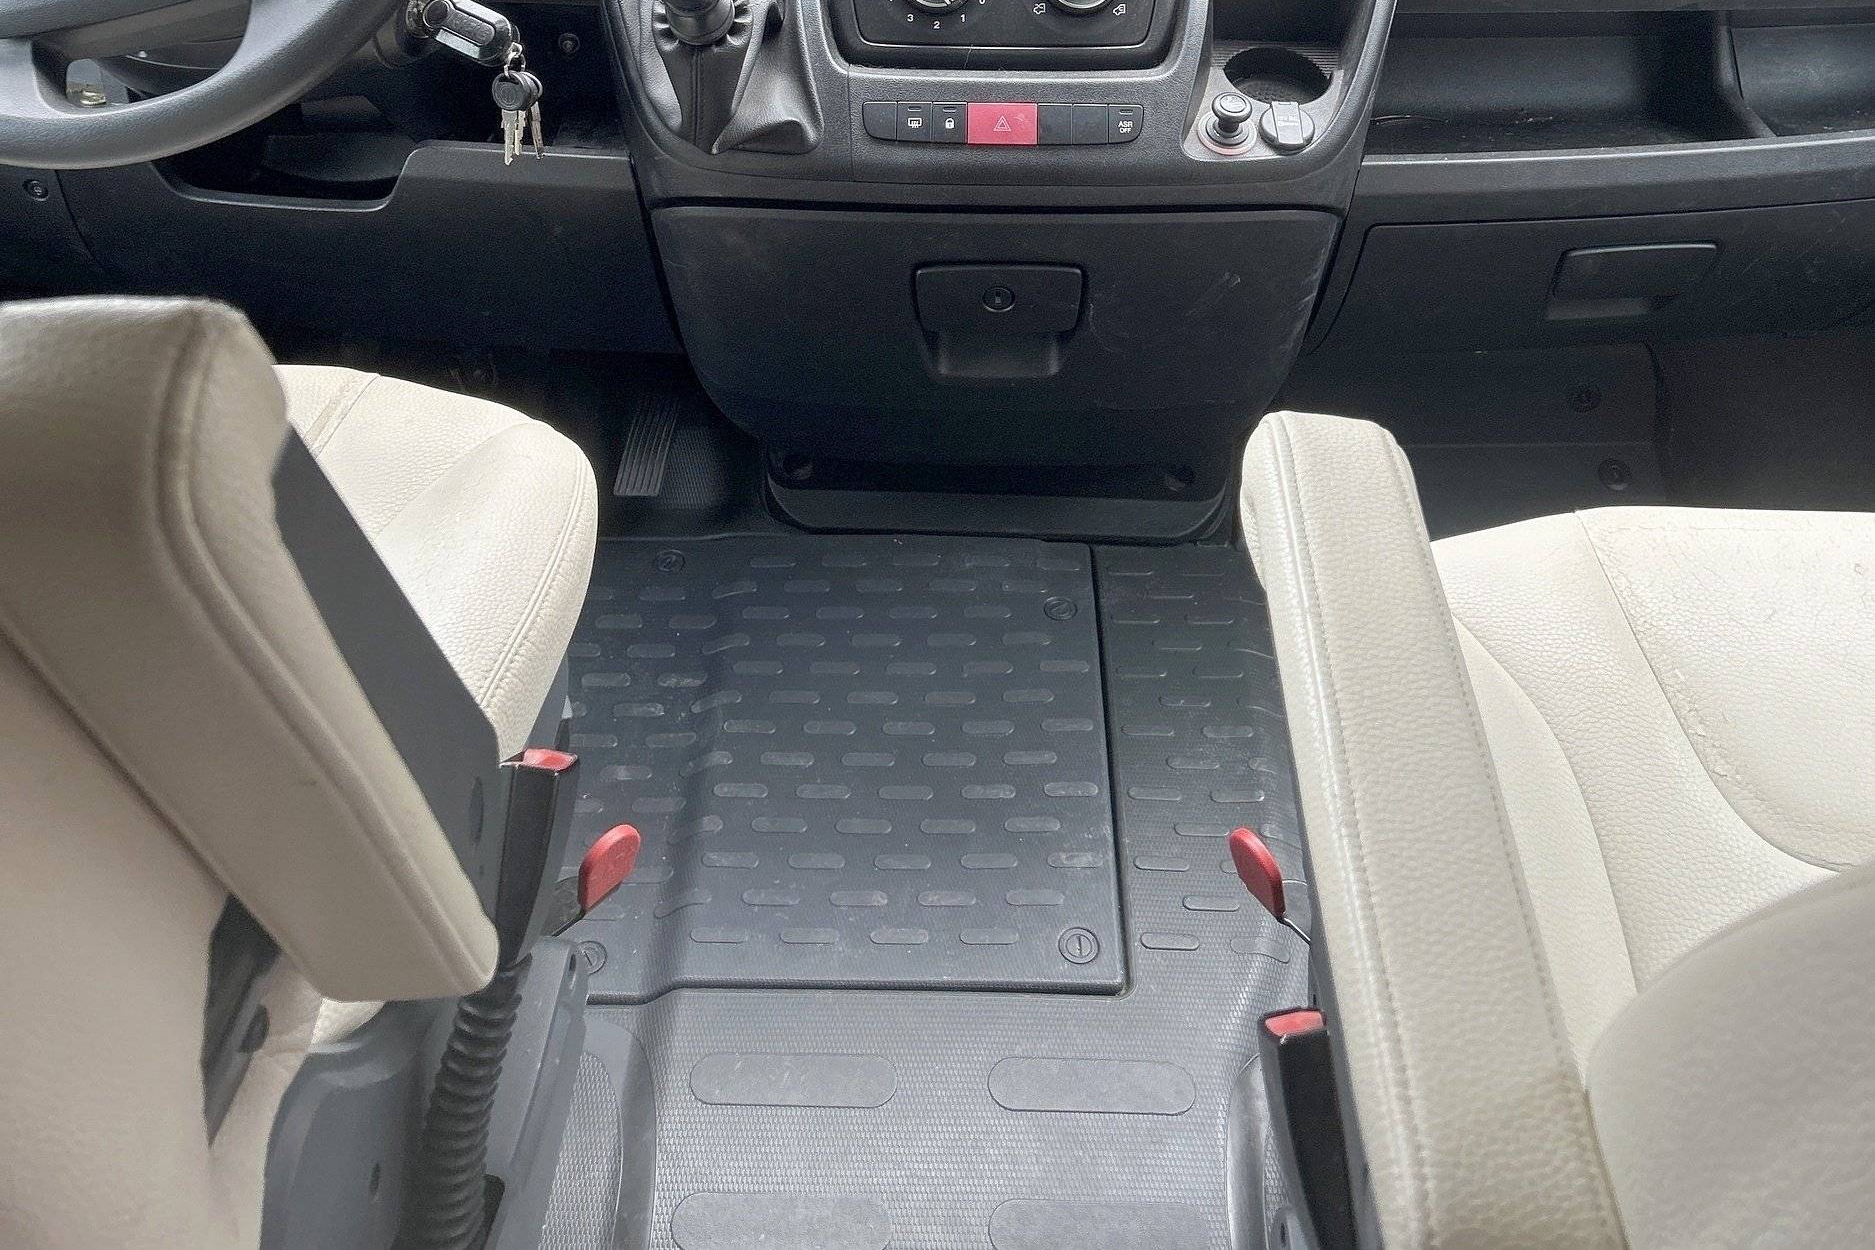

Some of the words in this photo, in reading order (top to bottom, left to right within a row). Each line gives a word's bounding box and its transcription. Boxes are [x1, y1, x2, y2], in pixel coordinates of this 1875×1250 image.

[906, 13, 914, 22] 3
[960, 14, 966, 23] 1
[933, 20, 941, 29] 2
[1117, 120, 1133, 128] ASR
